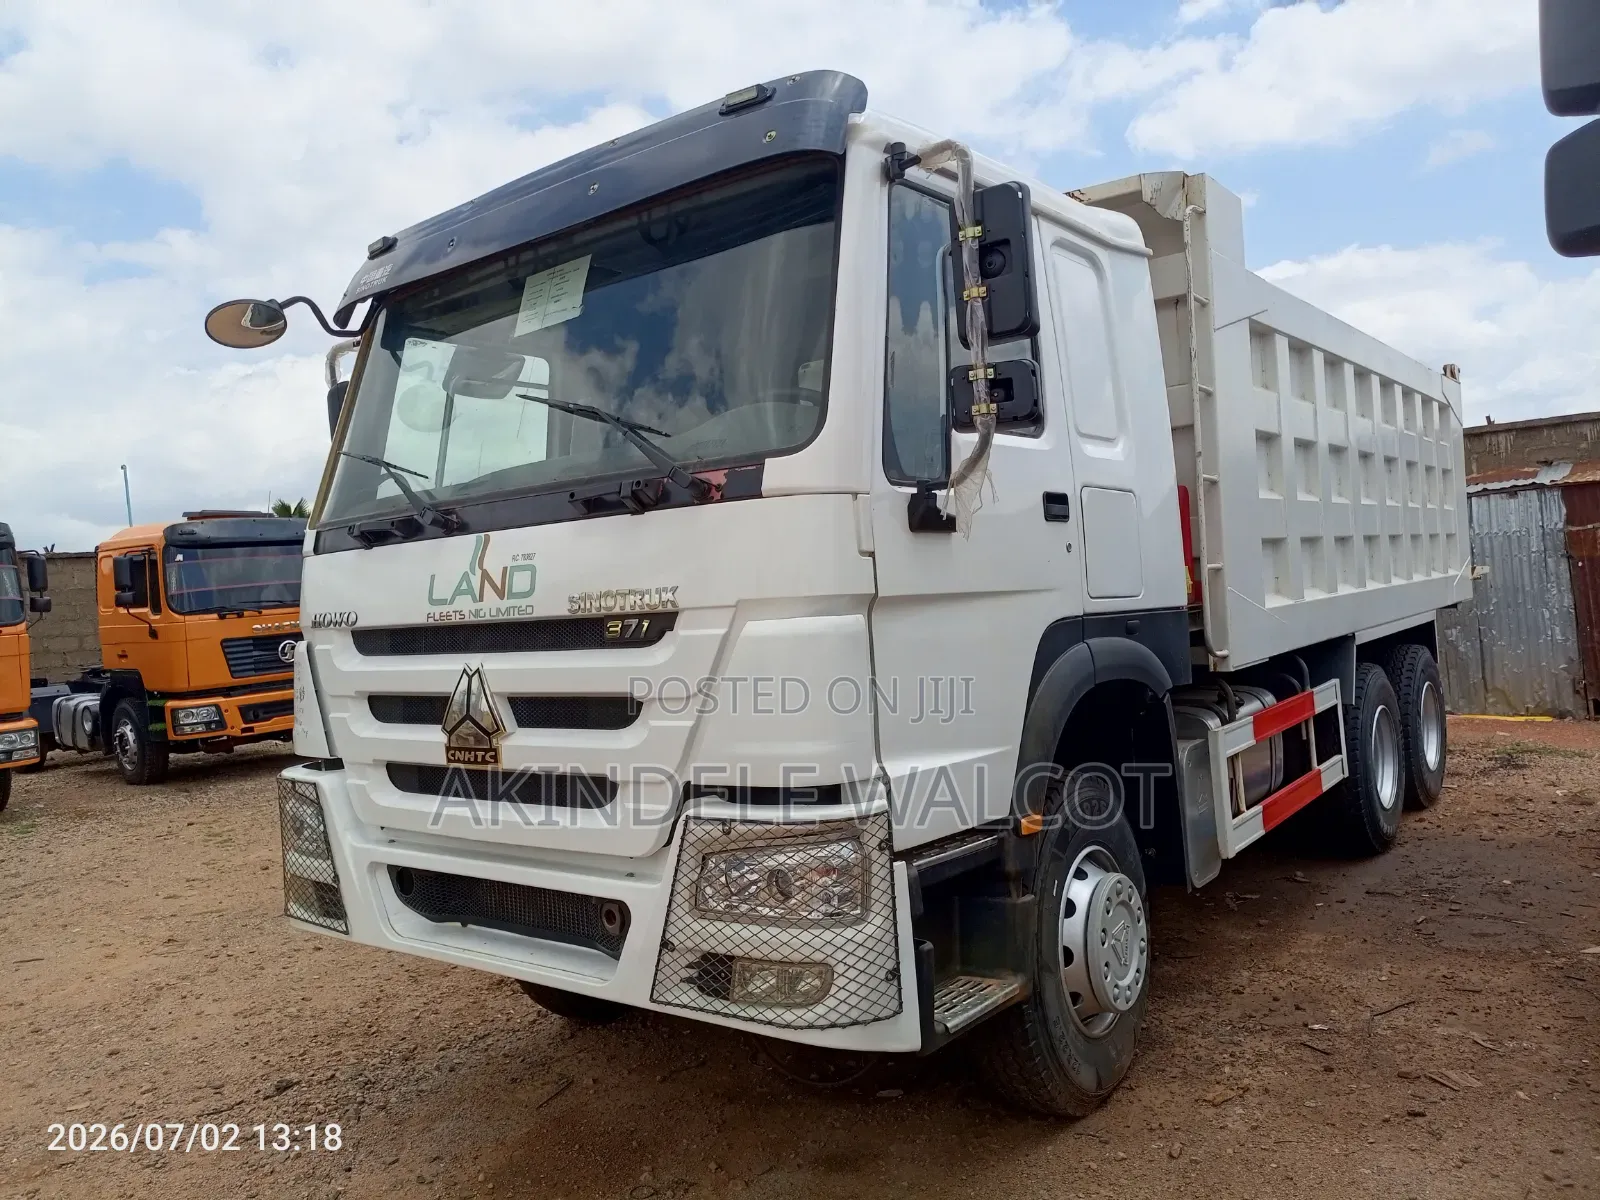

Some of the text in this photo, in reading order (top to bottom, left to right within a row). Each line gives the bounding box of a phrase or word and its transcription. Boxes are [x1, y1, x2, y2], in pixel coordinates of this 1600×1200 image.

[427, 563, 538, 607] LAND
[567, 586, 680, 615] SINOTRUK
[311, 611, 358, 629] HOWO
[426, 604, 535, 623] FLEETS NIG LIMITED
[605, 619, 651, 639] 371
[447, 750, 497, 763] CNHTC
